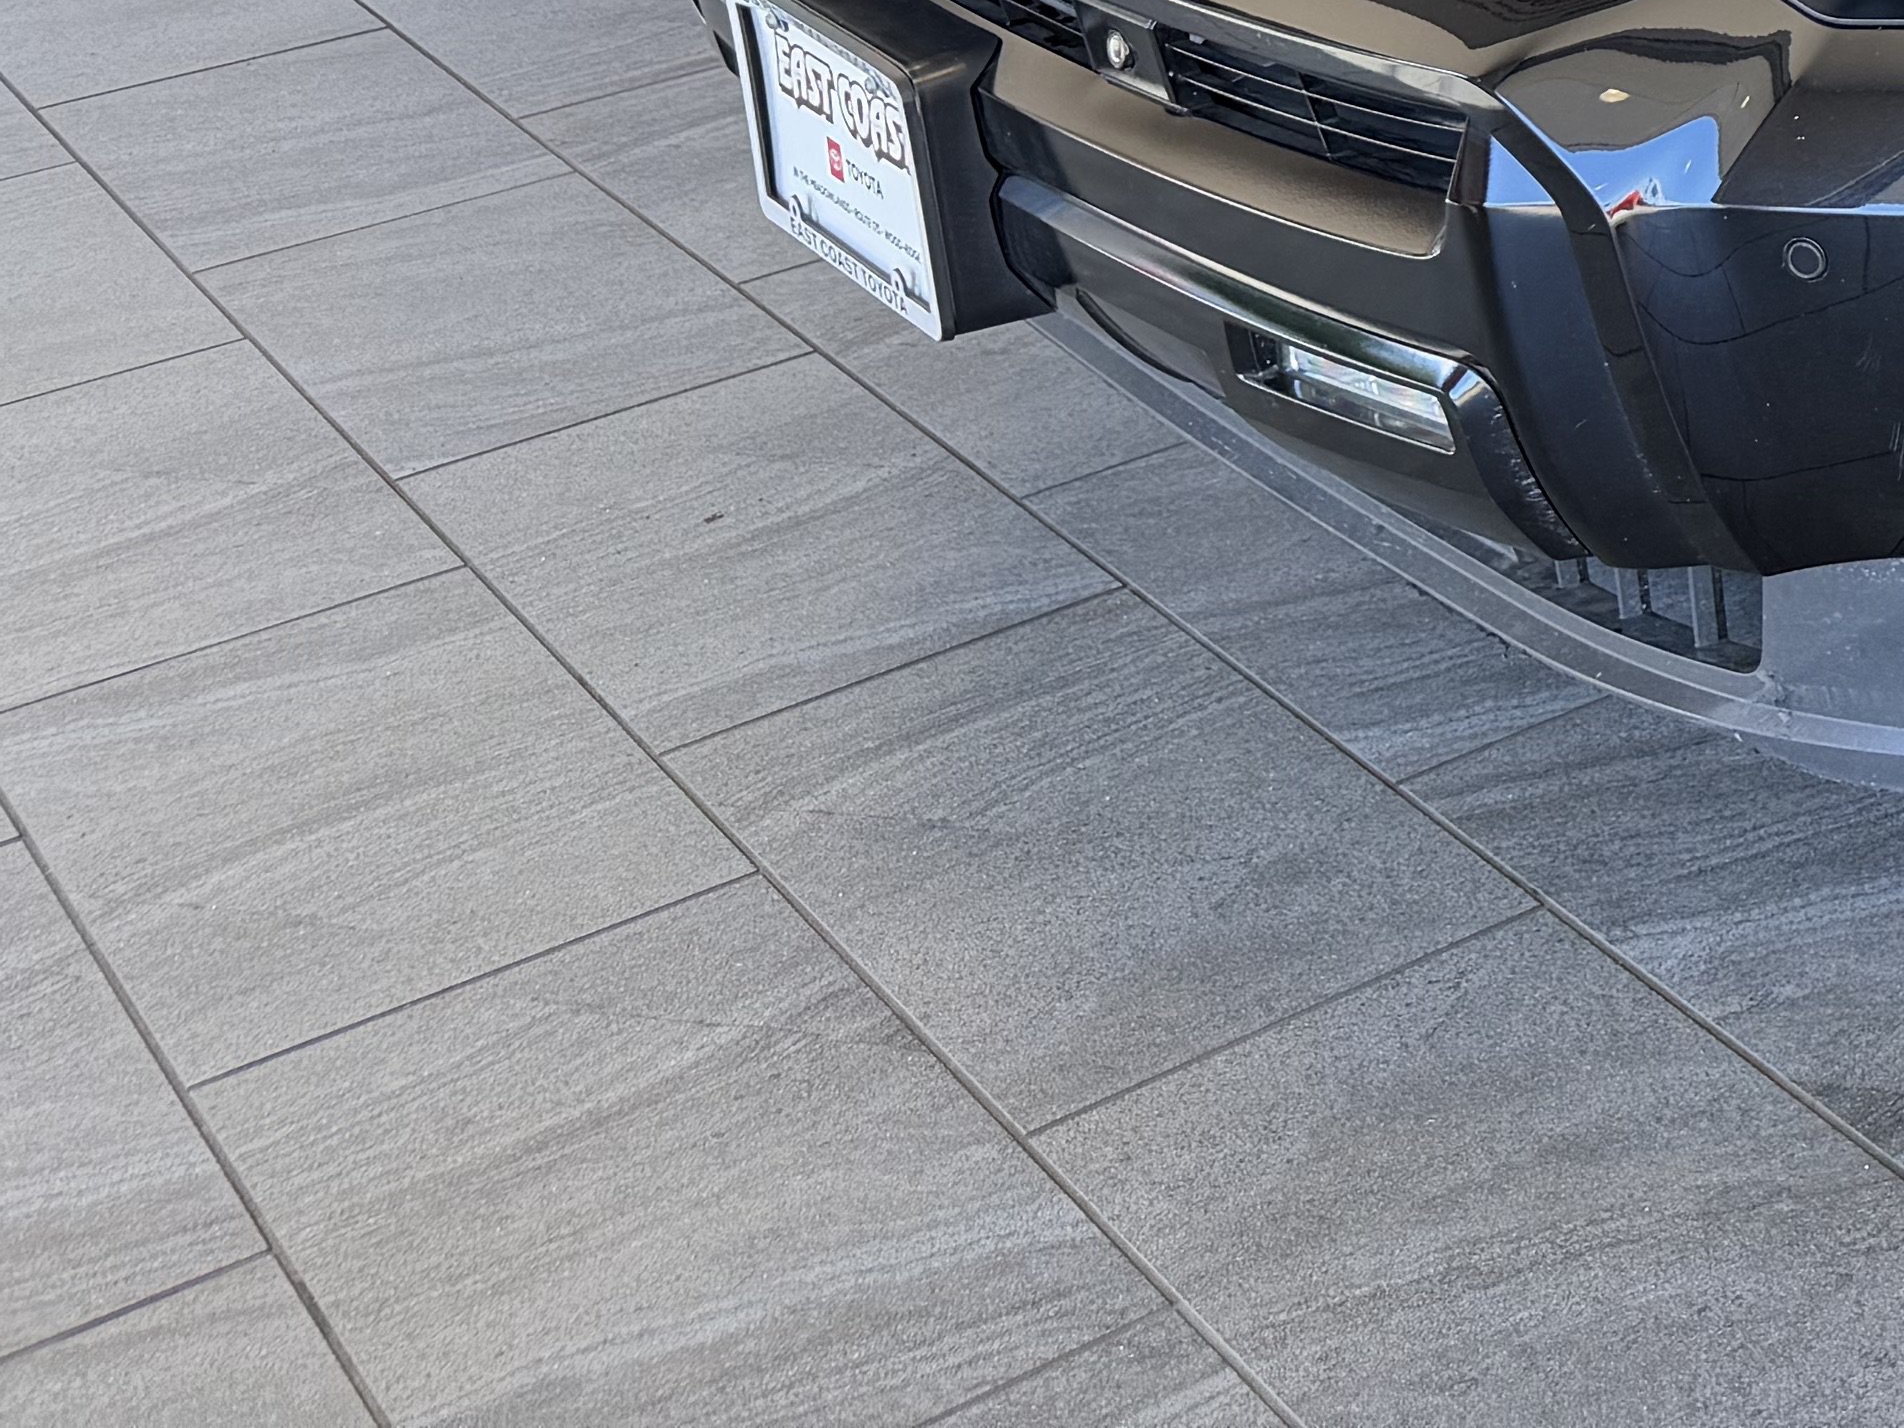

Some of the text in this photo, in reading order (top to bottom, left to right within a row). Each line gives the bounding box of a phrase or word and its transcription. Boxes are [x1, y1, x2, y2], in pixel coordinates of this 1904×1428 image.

[775, 32, 834, 124] EAST
[837, 73, 911, 175] COAS
[846, 159, 884, 199] TOYOTA
[790, 216, 908, 314] EAST COAST TOYOTA
